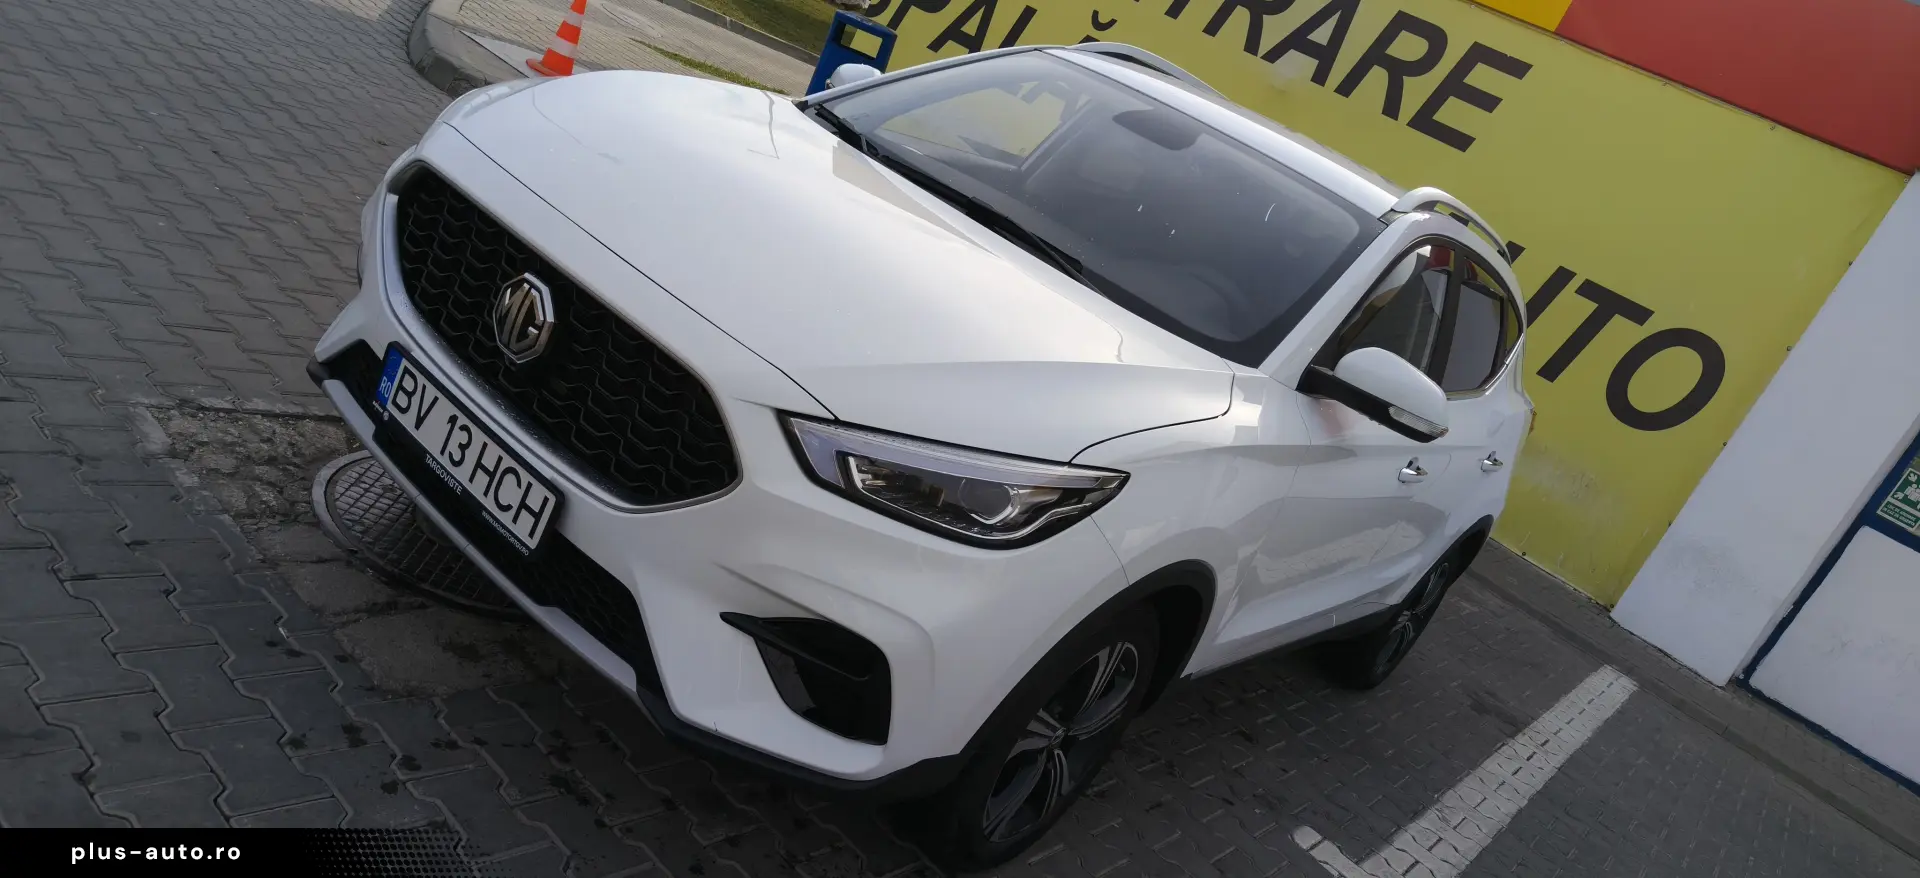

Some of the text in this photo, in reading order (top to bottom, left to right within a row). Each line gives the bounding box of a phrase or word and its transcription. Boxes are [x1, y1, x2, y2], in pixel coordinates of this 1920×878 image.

[1164, 0, 1534, 153] RARE
[497, 283, 544, 352] MG
[379, 375, 392, 398] RO
[391, 364, 550, 540] BV 13 HCH
[424, 453, 463, 496] TARGOVISTE
